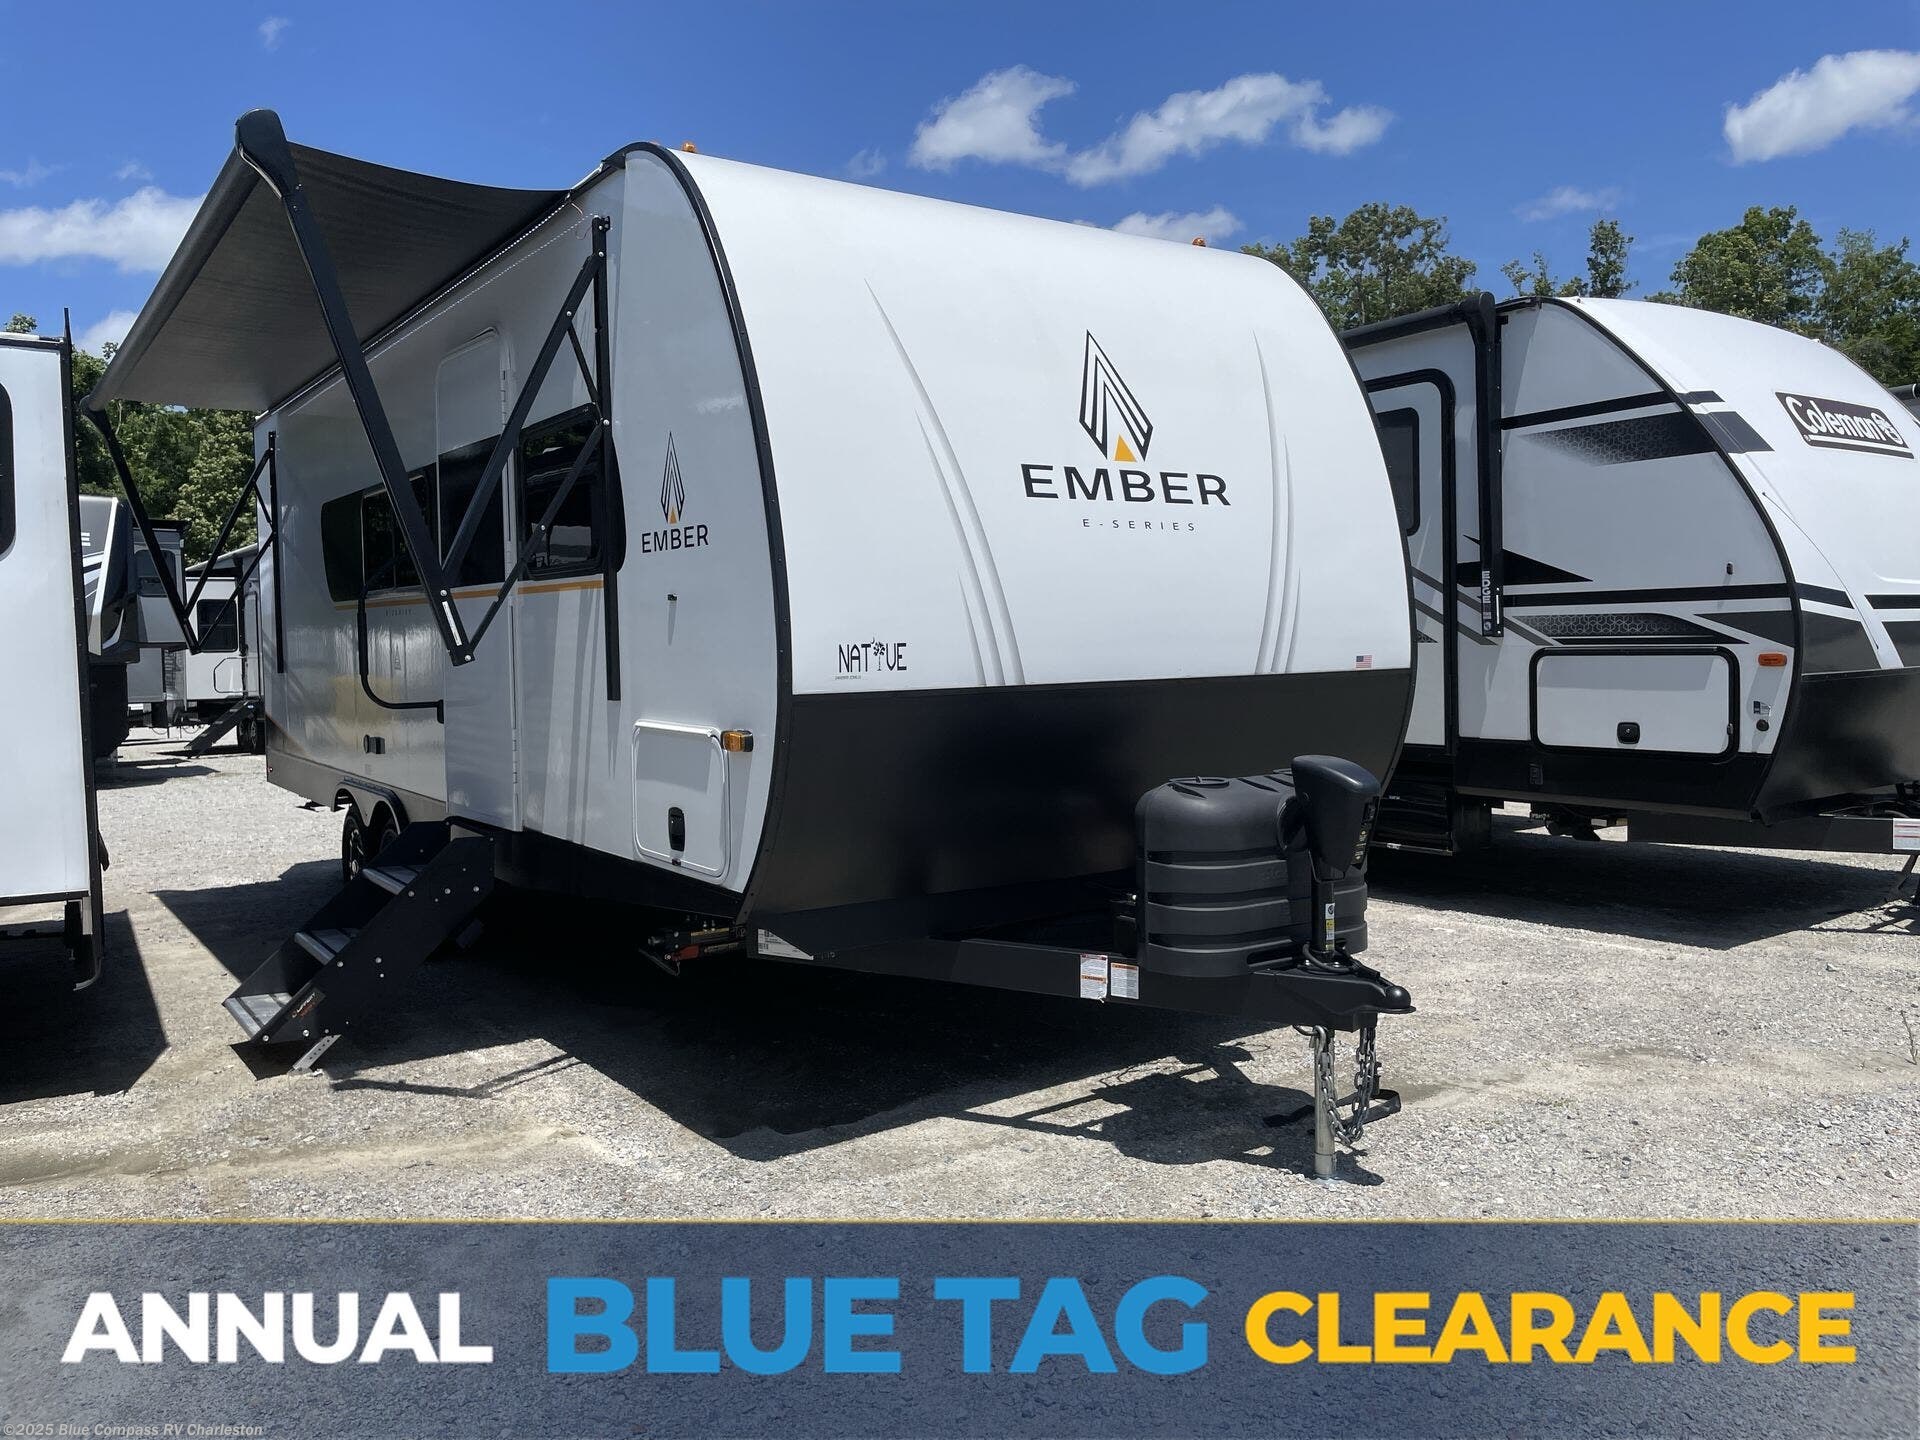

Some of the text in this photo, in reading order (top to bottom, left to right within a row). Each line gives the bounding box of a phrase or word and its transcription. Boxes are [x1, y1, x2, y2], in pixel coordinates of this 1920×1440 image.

[1785, 396, 1887, 441] Coleman
[1020, 463, 1231, 506] EMBER
[641, 524, 709, 553] EMBER
[1082, 518, 1195, 531] E-SERIES
[1481, 570, 1491, 604] EDGE
